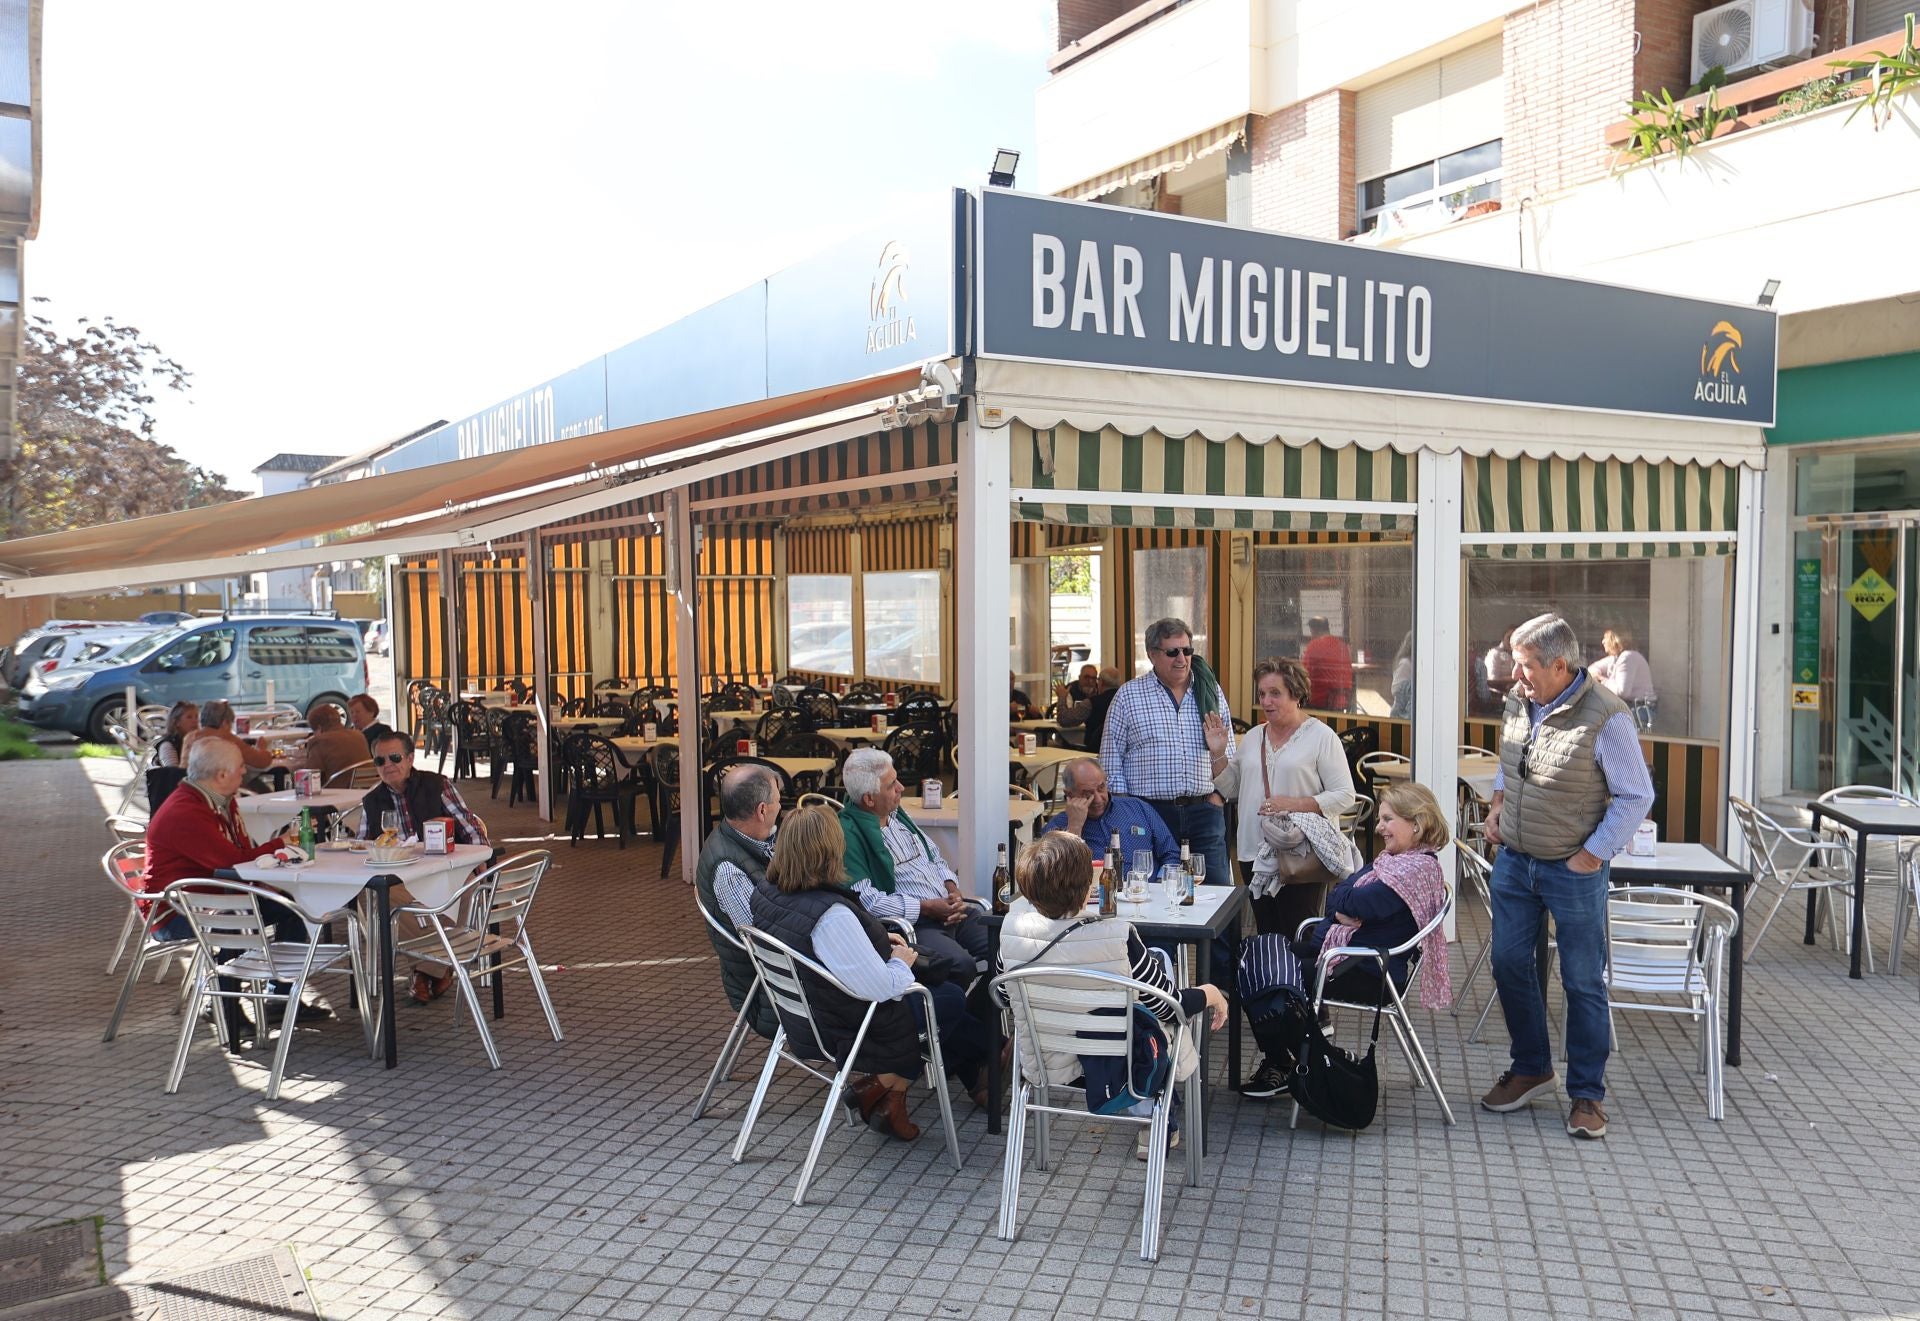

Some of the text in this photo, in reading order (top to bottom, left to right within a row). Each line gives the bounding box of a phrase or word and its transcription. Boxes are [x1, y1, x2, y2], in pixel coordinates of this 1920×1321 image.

[1032, 233, 1432, 369] BAR MIGUELITO
[1721, 371, 1729, 383] EL
